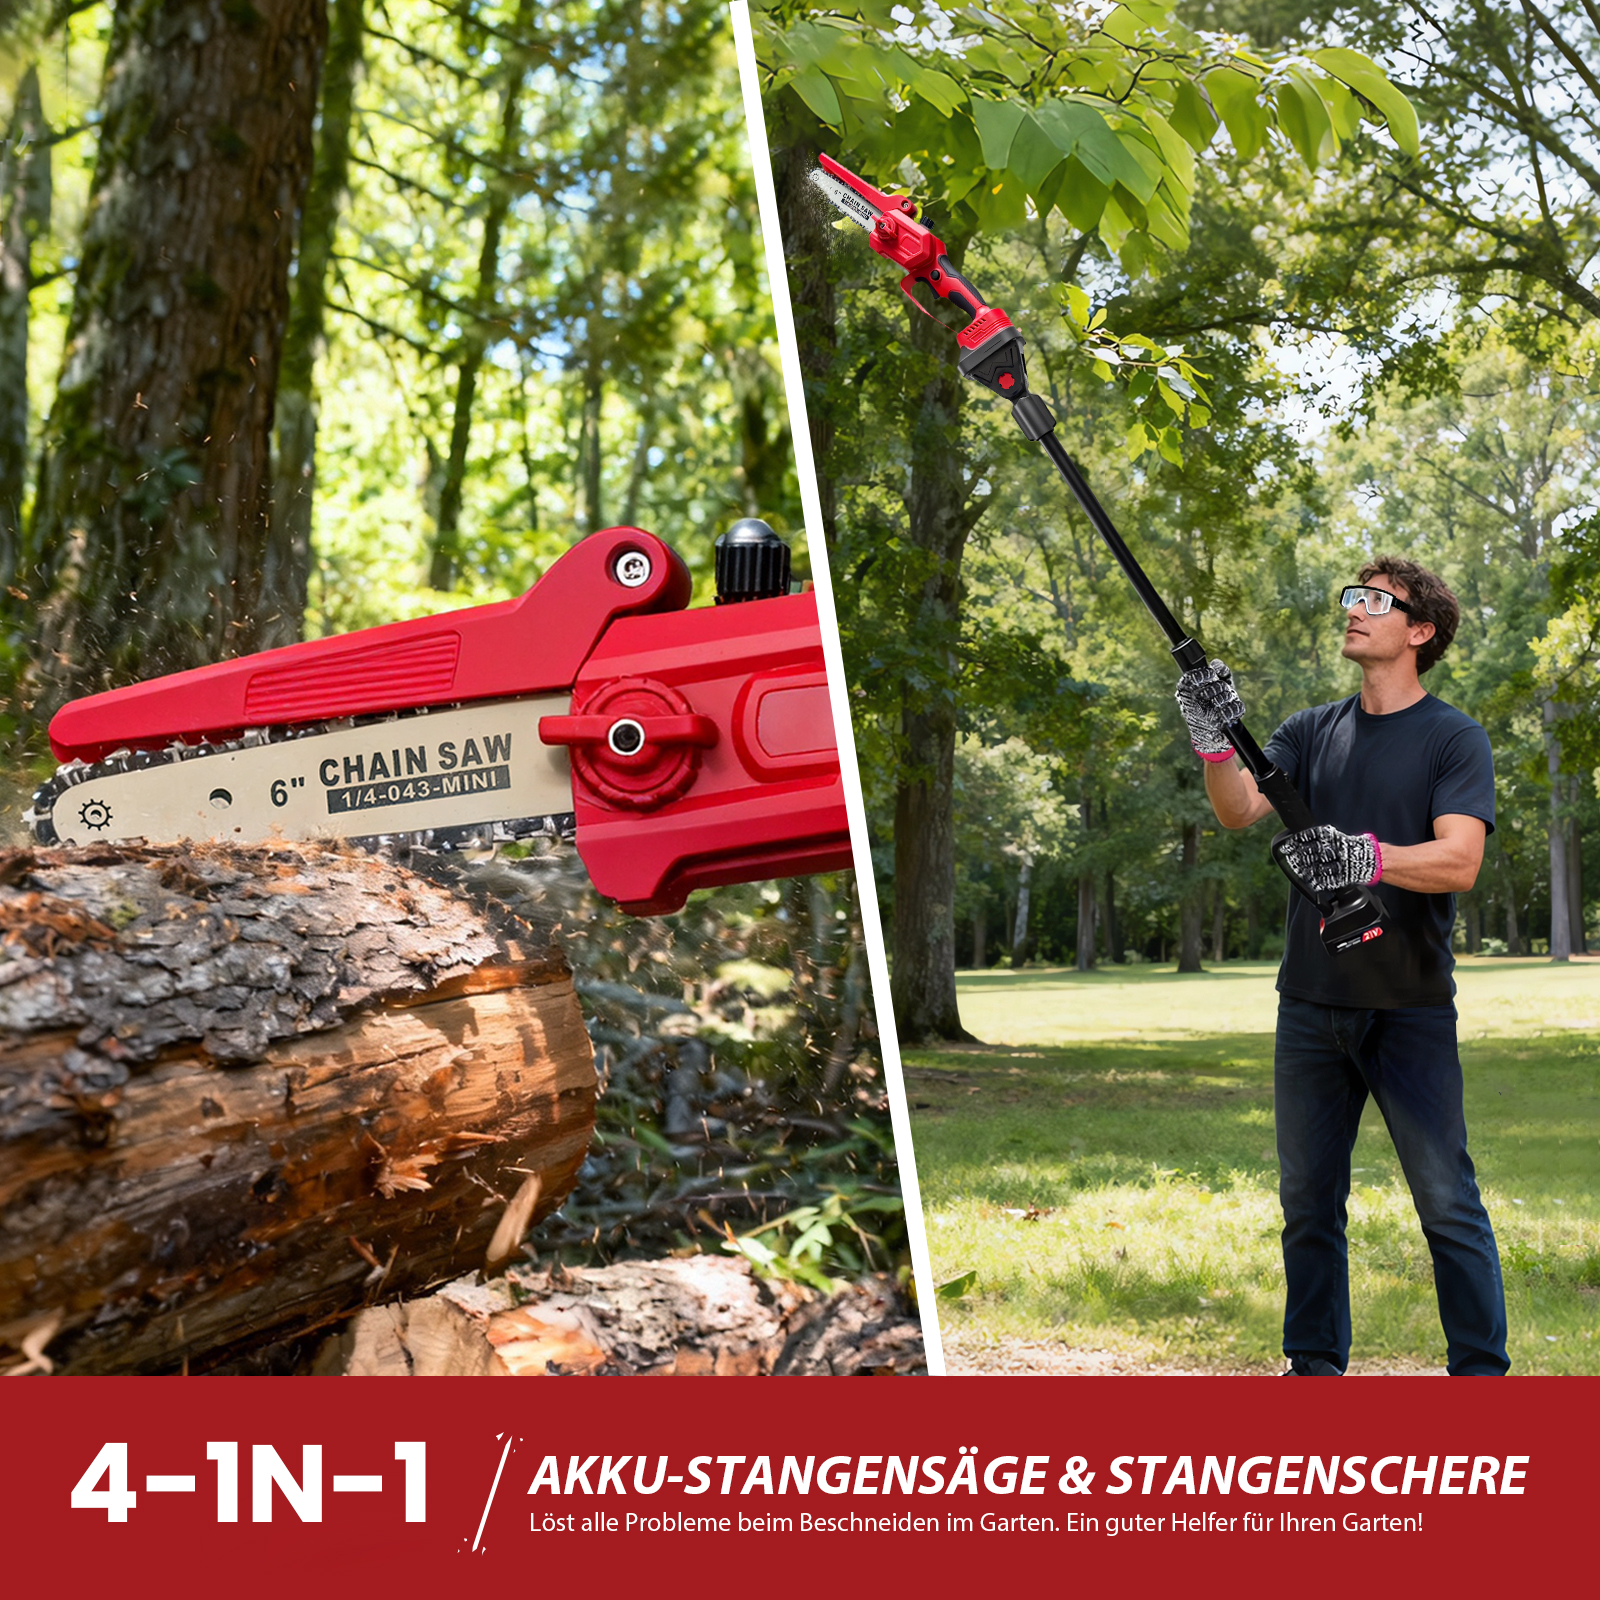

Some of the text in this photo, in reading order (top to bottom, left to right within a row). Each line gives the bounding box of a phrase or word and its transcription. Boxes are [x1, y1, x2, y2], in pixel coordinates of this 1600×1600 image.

[842, 192, 861, 208] CHAIN
[861, 205, 874, 216] SAW
[270, 732, 512, 808] 6" CHAIN SAW
[340, 769, 498, 808] 1/4-043-MINI
[1363, 928, 1379, 941] 21V
